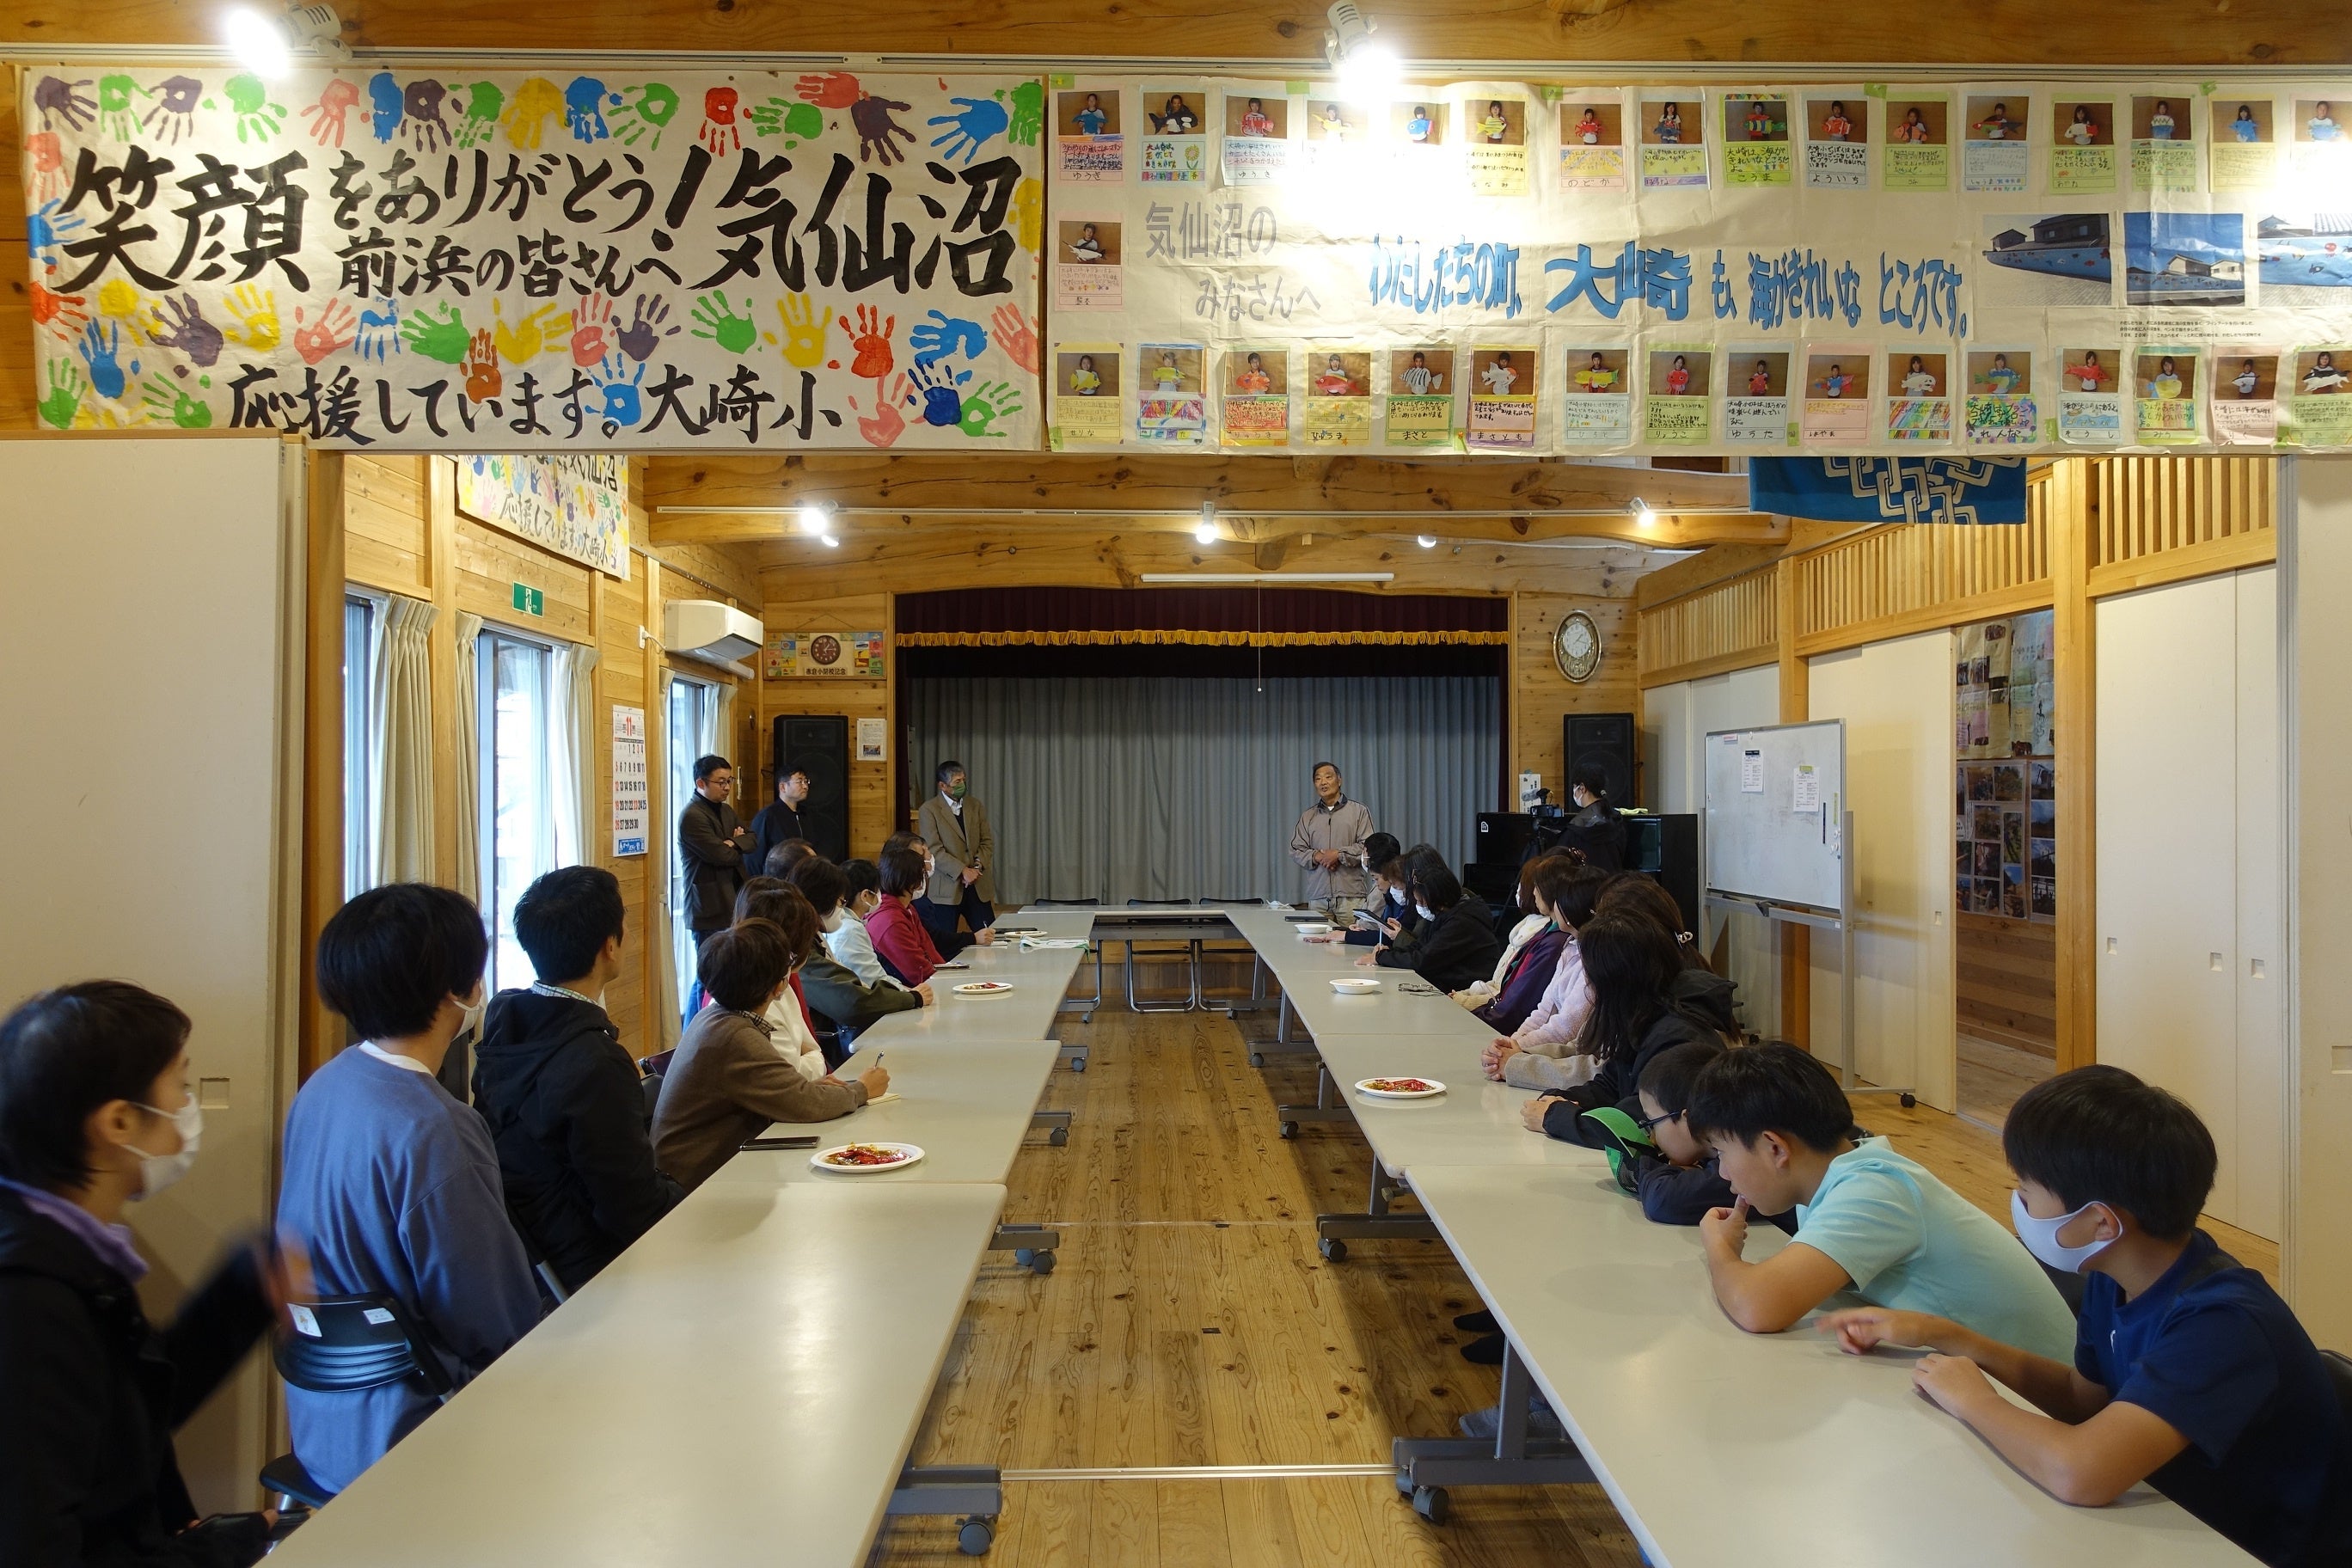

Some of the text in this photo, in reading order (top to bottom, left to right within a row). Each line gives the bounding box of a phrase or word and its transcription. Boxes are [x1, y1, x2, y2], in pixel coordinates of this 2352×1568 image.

[1813, 174, 1859, 184] よういち
[52, 144, 310, 293] 笑顔
[685, 147, 1023, 296] 気仙沼
[1146, 201, 1277, 260] 気仙沼の
[336, 227, 683, 297] 前浜の皆さんへ
[1544, 240, 1692, 321] 大崎
[1195, 274, 1322, 322] みなさんへ
[1403, 431, 1428, 440] まさと
[1478, 432, 1522, 440] まさとも
[1732, 430, 1773, 438] ゆうた
[626, 716, 632, 736] 11
